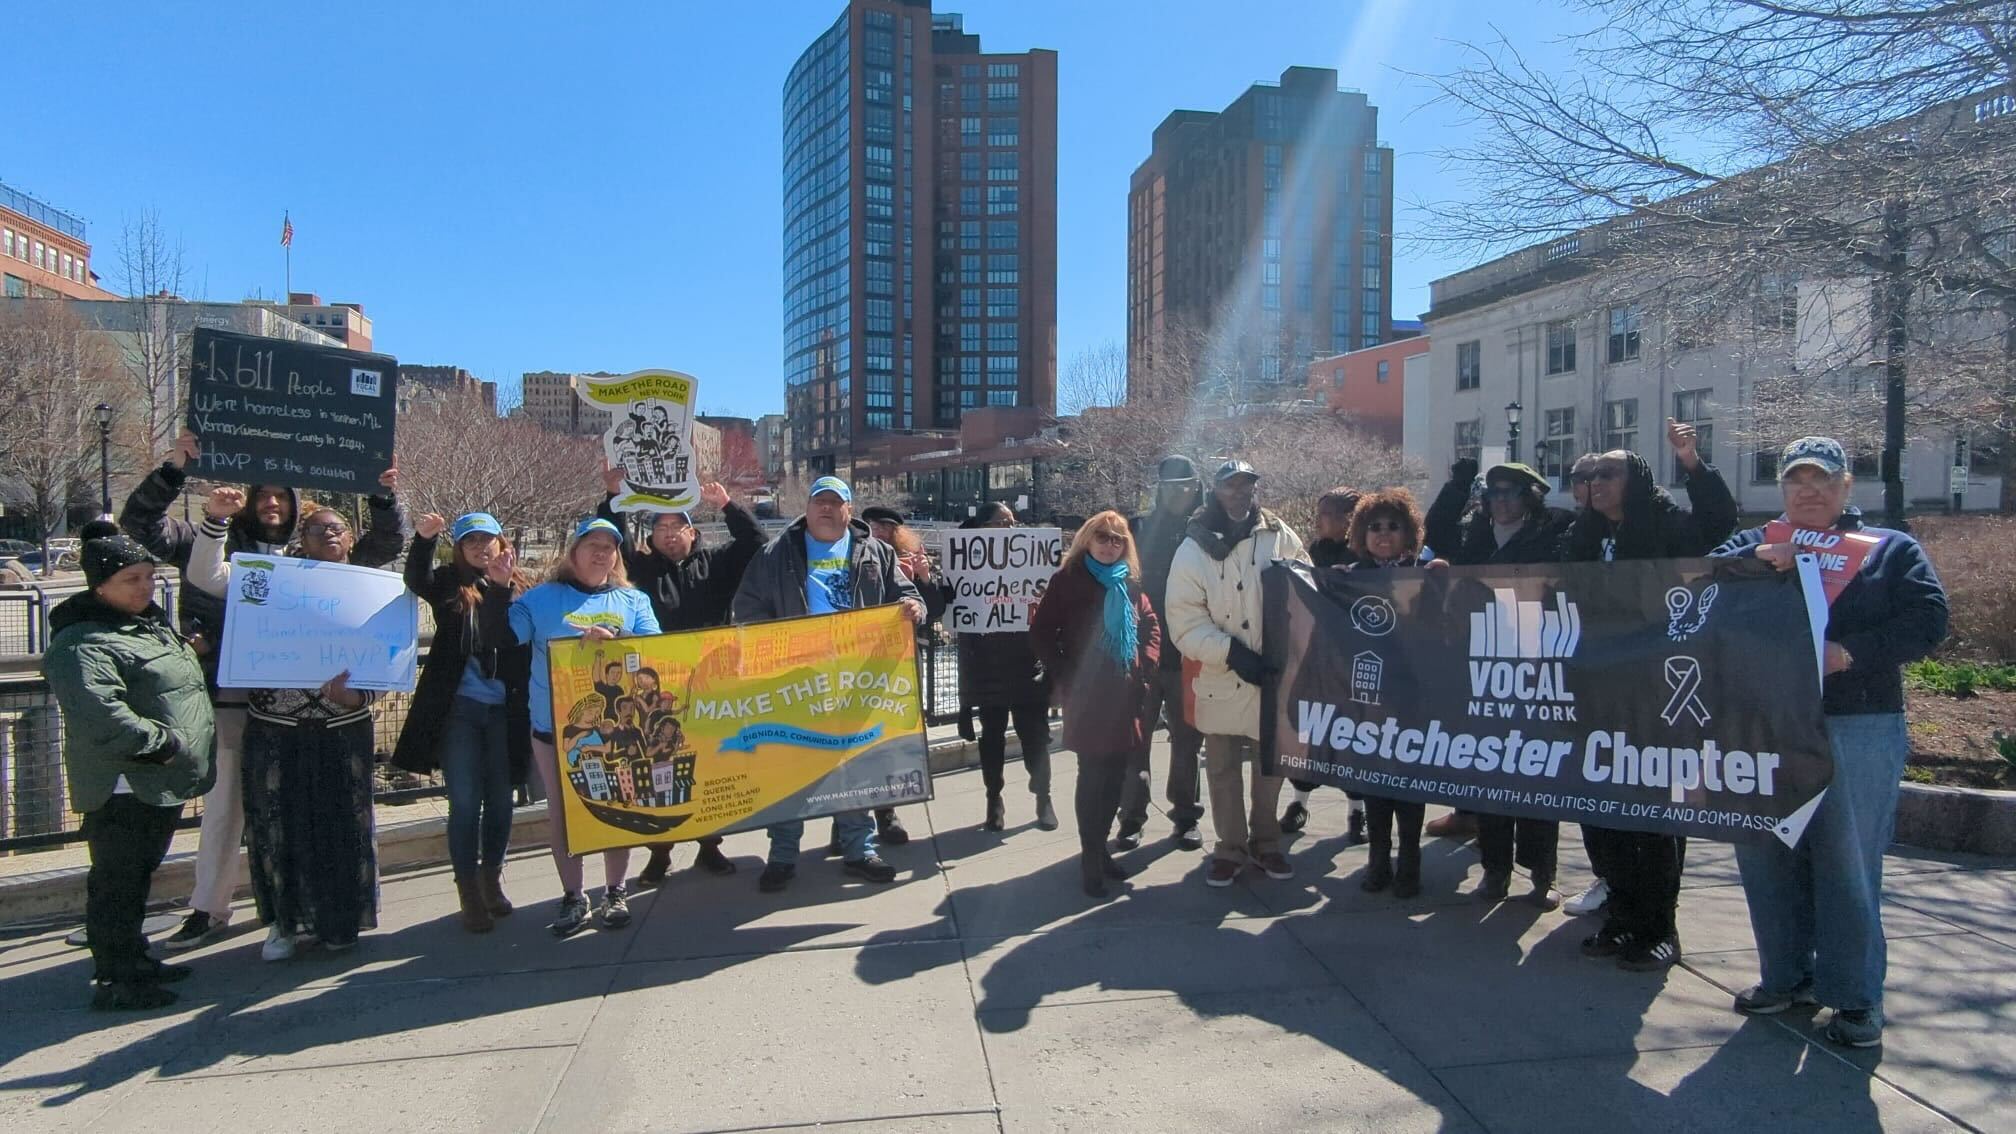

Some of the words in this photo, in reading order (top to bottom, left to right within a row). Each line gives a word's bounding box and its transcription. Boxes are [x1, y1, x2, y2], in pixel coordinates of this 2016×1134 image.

[599, 384, 630, 397] MAKE
[631, 379, 653, 389] THE
[655, 379, 688, 392] ROAD
[640, 388, 662, 397] NEW
[662, 390, 686, 400] YORK
[285, 458, 304, 473] the
[1791, 528, 1840, 548] HOLD
[946, 576, 1049, 600] Vouchers
[986, 603, 1021, 628] ALL
[1469, 660, 1574, 701] VOCAL
[695, 692, 774, 719] MAKE
[777, 673, 832, 706] THE
[839, 671, 912, 696] ROAD
[809, 696, 853, 716] NEW
[860, 695, 909, 716] YORK
[1468, 700, 1516, 719] NEW
[1524, 703, 1578, 722] YORK
[790, 732, 839, 746] COMUNIDAD
[848, 731, 874, 744] PODER
[1297, 701, 1573, 777] Westchester
[1582, 730, 1781, 803] Chapter
[704, 773, 748, 787] BROOKLYN
[702, 793, 732, 805] STATEN
[734, 787, 761, 798] ISLAND
[703, 784, 736, 796] QUEENS
[1280, 755, 1330, 774] FIGHTING
[1331, 763, 1353, 779] FOR
[1355, 769, 1409, 789] JUSTICE
[1410, 778, 1437, 792] AND
[1438, 782, 1486, 799] EQUITY
[1487, 788, 1522, 804] WITH
[1523, 793, 1534, 805] A
[1535, 793, 1596, 812] POLITICS
[1600, 800, 1619, 814] OF
[1621, 802, 1660, 819] LOVE
[1662, 806, 1694, 823] AND
[1698, 810, 1786, 832] COMPASSI
[695, 806, 753, 823] WESTCHESTER
[701, 804, 723, 814] LONG
[725, 798, 754, 809] ISLAND
